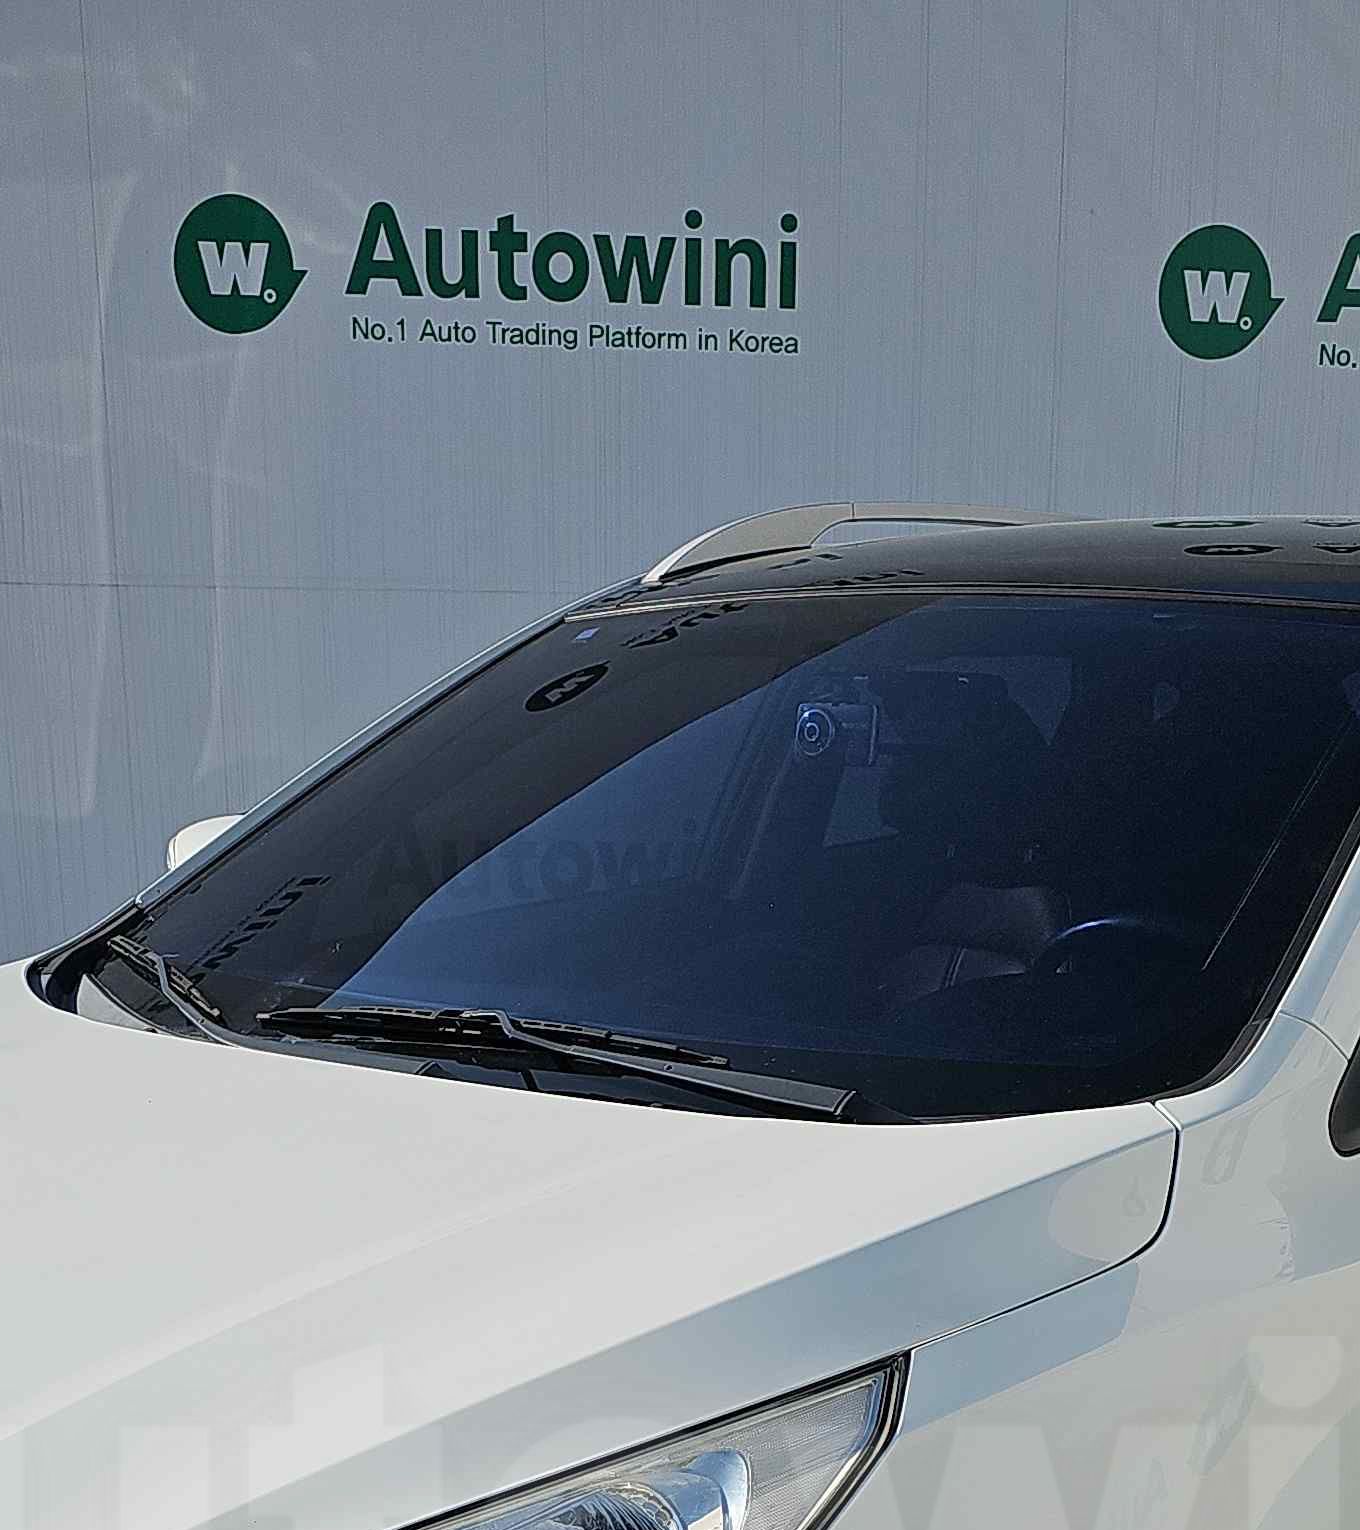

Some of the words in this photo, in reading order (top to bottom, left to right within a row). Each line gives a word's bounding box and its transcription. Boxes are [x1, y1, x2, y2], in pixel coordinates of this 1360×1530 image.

[345, 201, 798, 310] Autowini
[352, 316, 405, 343] No.1
[419, 319, 477, 344] Auto
[485, 321, 578, 350] Trading
[589, 324, 687, 350] Platform
[698, 327, 718, 351] in
[729, 329, 799, 354] Korea
